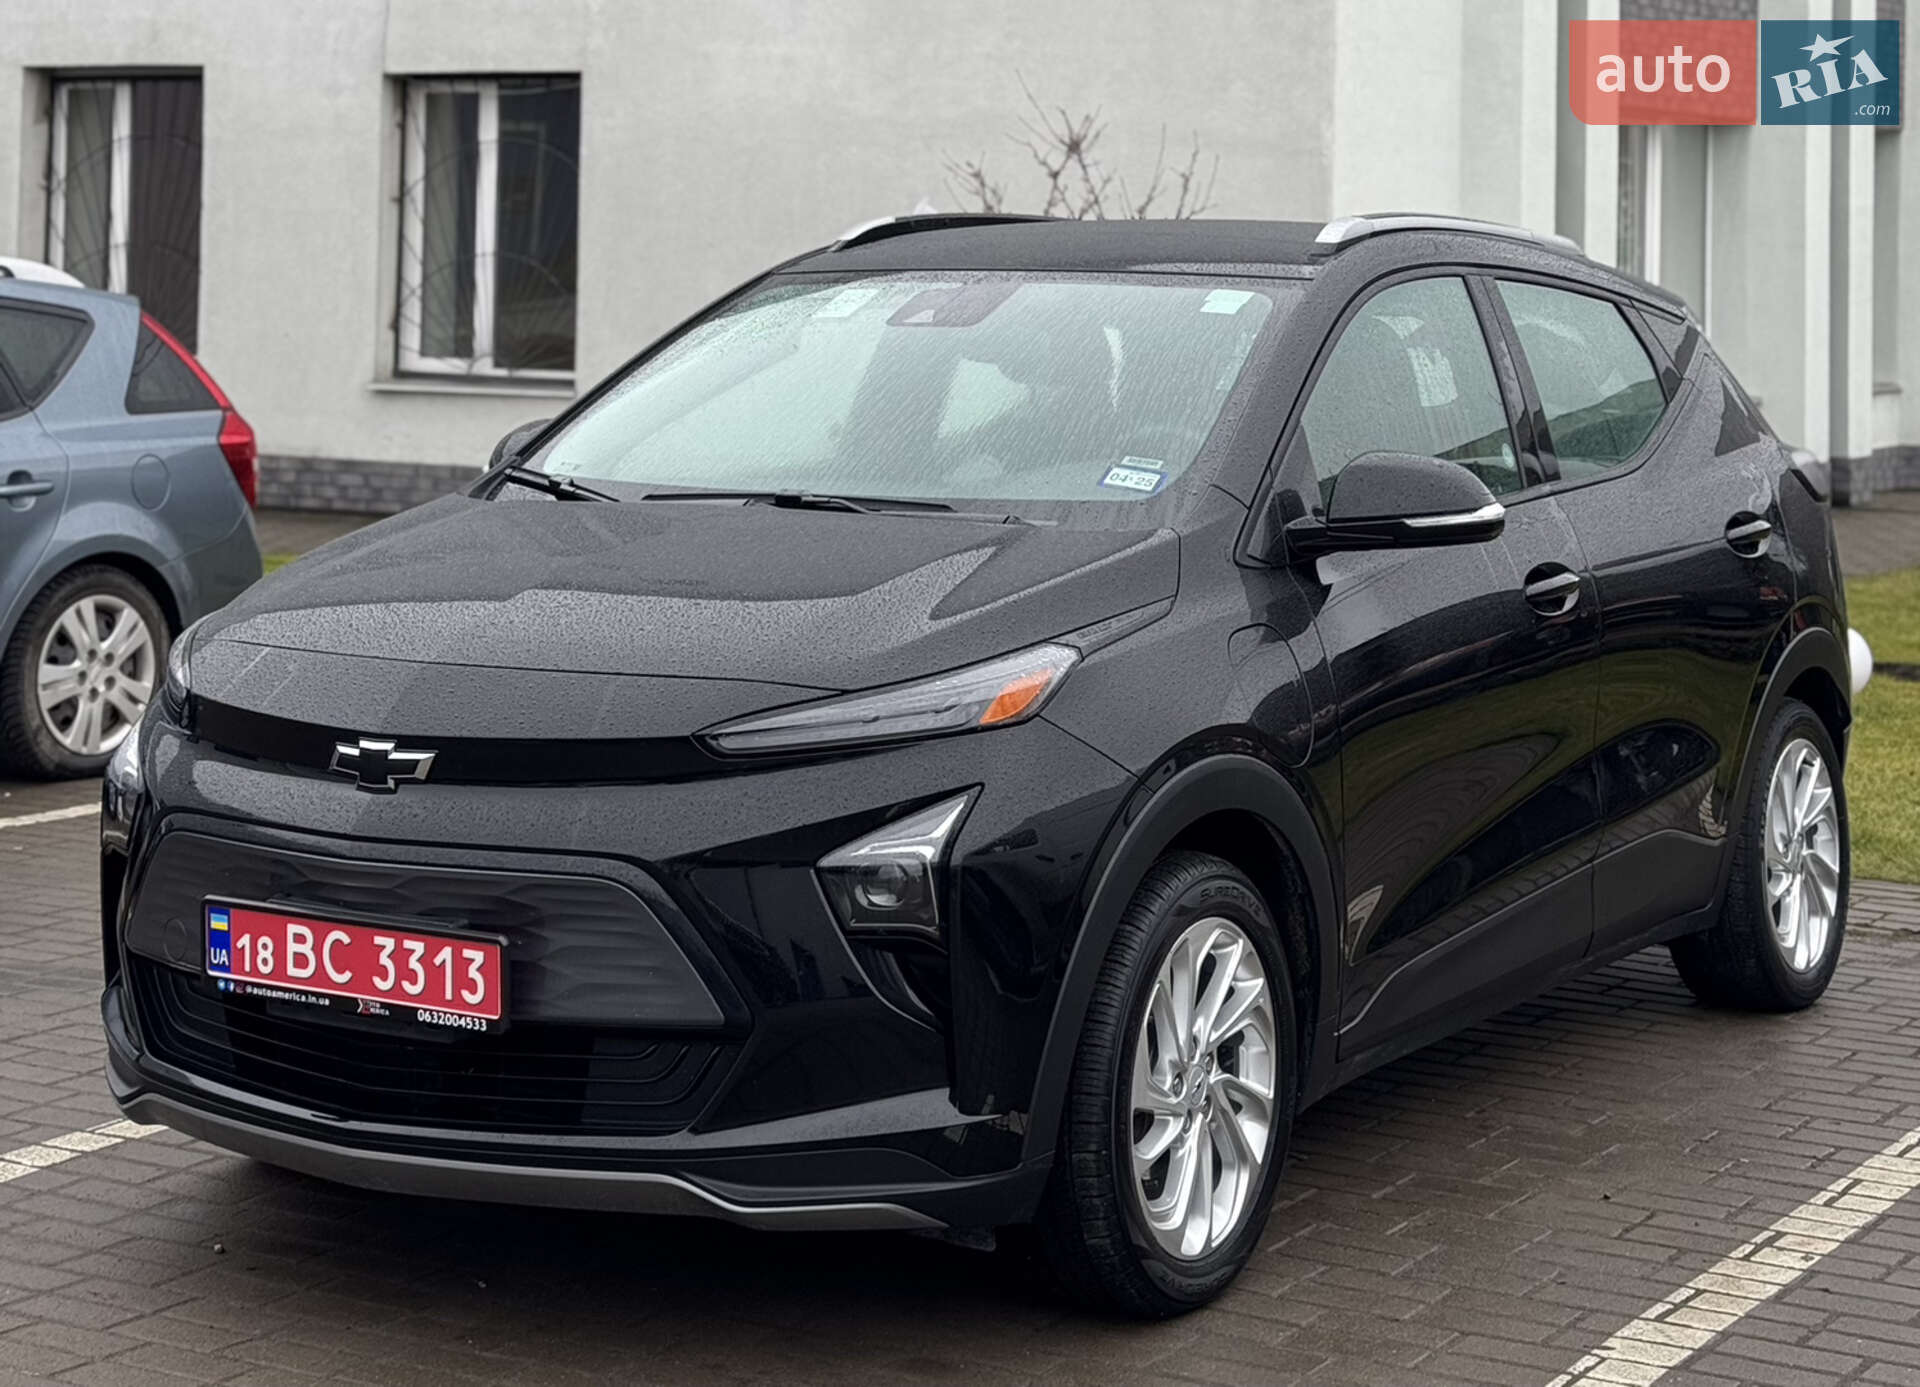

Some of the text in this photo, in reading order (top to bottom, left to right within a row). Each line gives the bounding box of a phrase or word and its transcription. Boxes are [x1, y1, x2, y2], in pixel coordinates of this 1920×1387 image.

[210, 922, 486, 1006] UA 18 BC 3313
[416, 1009, 487, 1031] 0632004533
